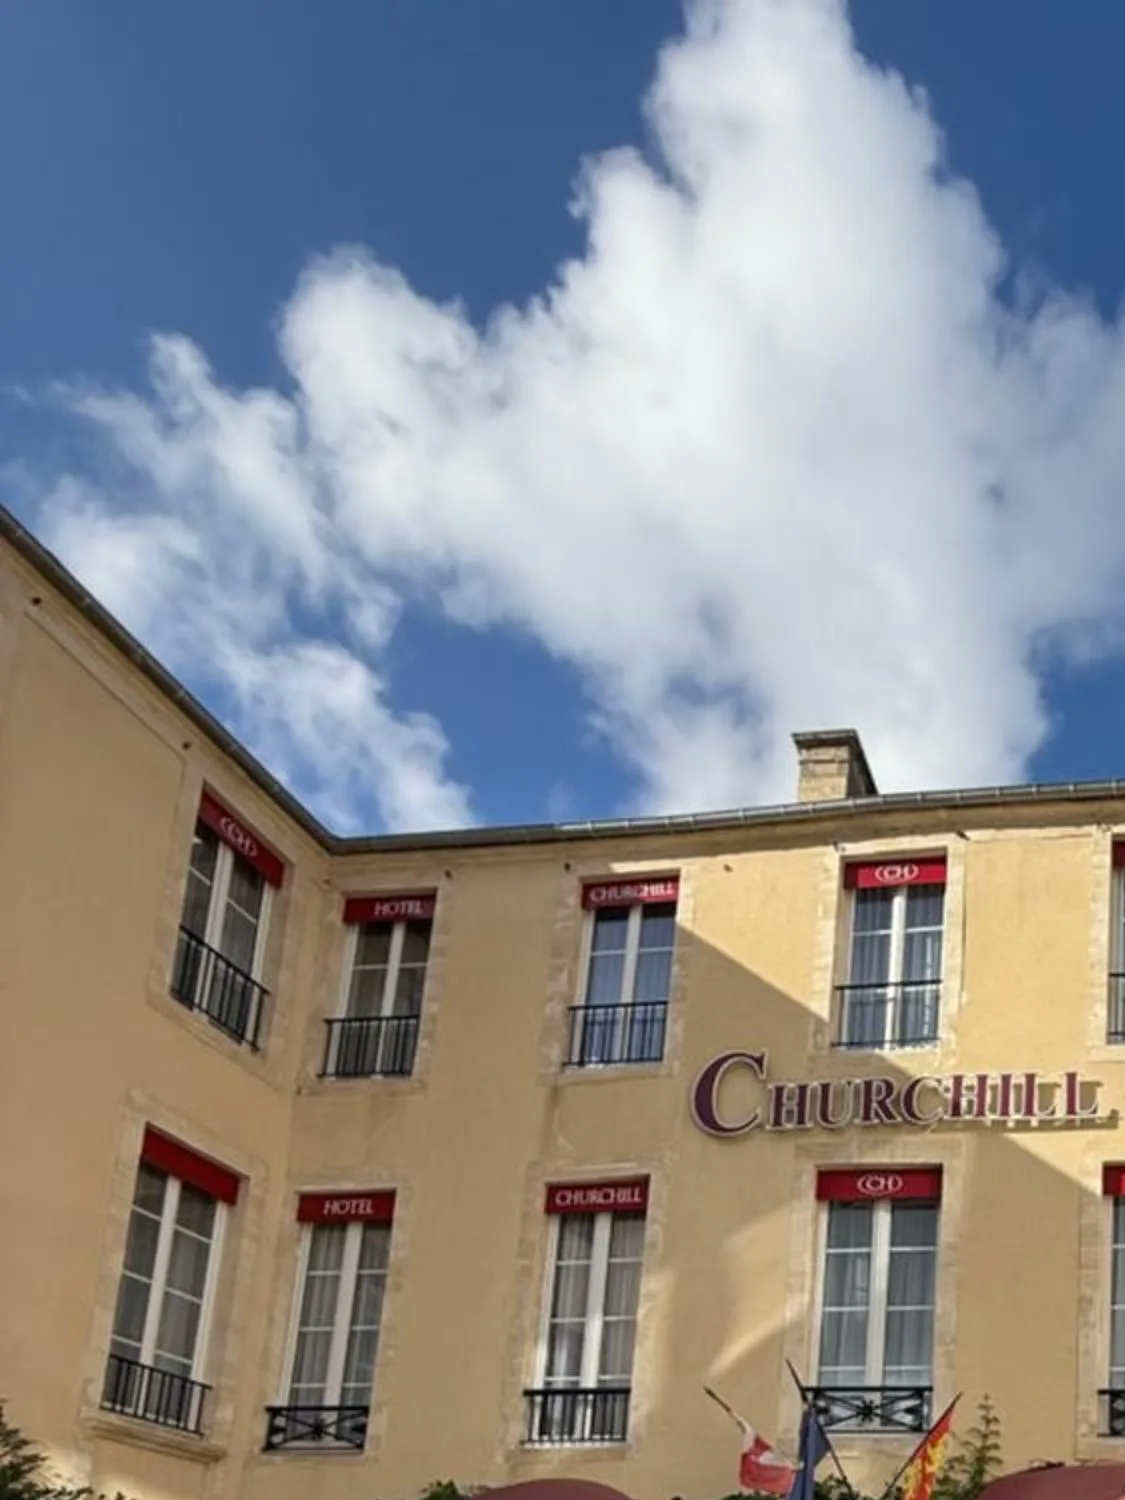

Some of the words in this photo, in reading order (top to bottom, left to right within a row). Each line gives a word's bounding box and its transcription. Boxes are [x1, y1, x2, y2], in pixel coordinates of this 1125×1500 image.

[373, 900, 423, 916] HOTEL
[690, 1050, 1102, 1136] CHURCHILL
[323, 1199, 374, 1215] HOTEL
